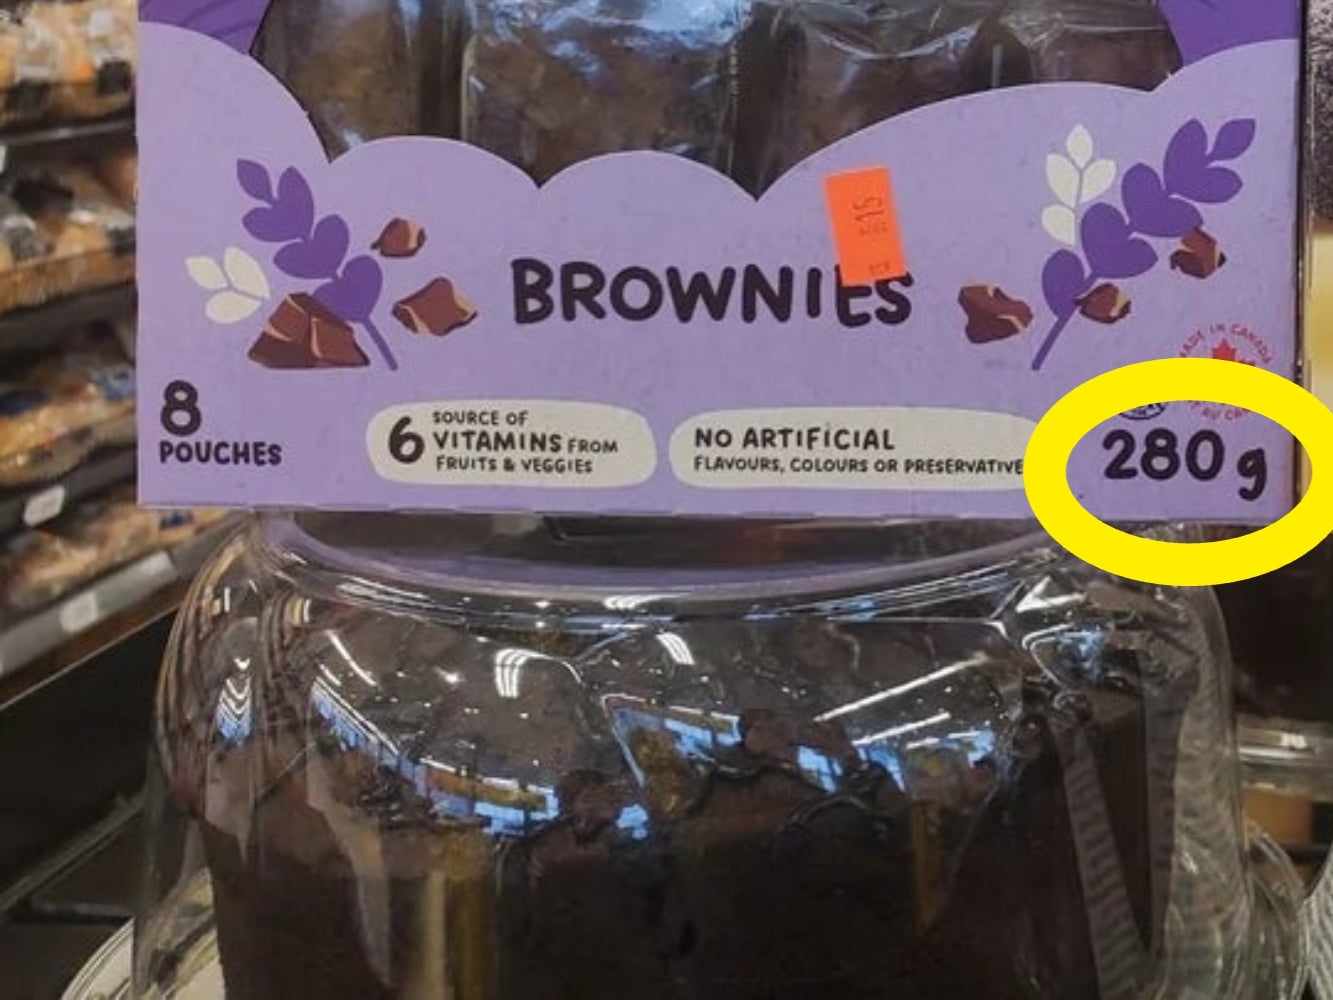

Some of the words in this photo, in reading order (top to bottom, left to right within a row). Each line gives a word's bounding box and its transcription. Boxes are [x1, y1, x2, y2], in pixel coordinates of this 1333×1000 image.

[511, 257, 914, 328] BROWNIES
[159, 379, 203, 438] 8
[432, 410, 500, 426] SOURCE
[505, 410, 530, 427] OF
[388, 415, 426, 465] 6
[432, 430, 563, 453] VITAMINS
[567, 438, 619, 453] FROM
[694, 427, 733, 449] NO
[742, 425, 896, 450] ARTIFICIAL
[158, 441, 283, 467] POUCHES
[435, 455, 498, 473] FRUITS
[502, 457, 516, 472] &
[520, 457, 594, 474] VEGGIES
[693, 455, 787, 474] FLAVOURS,
[789, 457, 868, 474] COLOURS
[873, 456, 899, 473] OR
[903, 458, 1024, 476] PRESERVATIVE
[1101, 427, 1226, 482] 280
[1236, 447, 1268, 501] g
